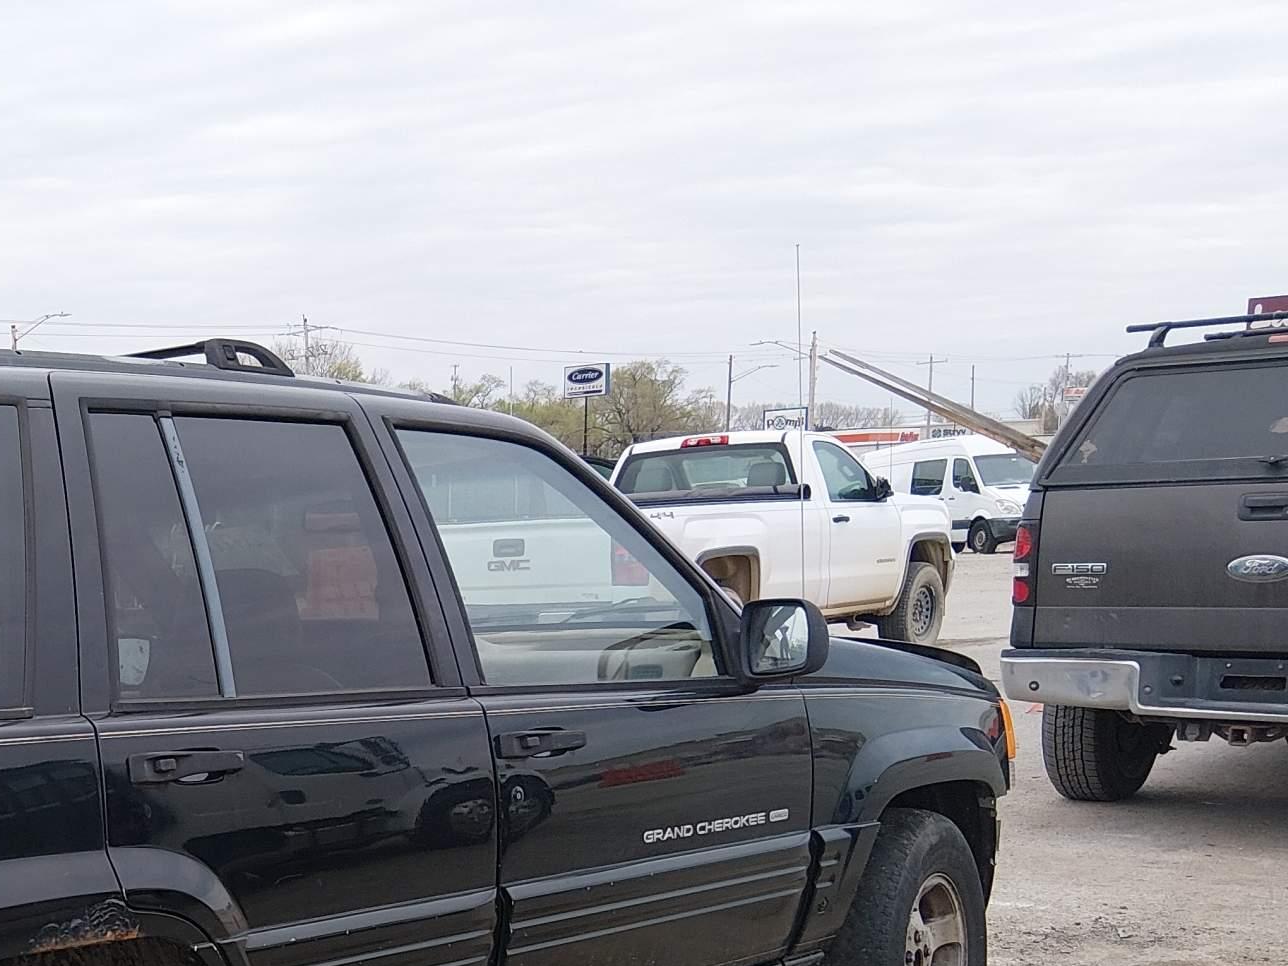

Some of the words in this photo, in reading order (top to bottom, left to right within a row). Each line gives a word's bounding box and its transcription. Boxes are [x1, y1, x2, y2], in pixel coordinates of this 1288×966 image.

[572, 371, 600, 381] Carrier
[487, 560, 531, 572] GMC
[1242, 559, 1279, 574] Ford
[643, 824, 694, 844] GRAND
[696, 812, 766, 835] CHEROKEE
